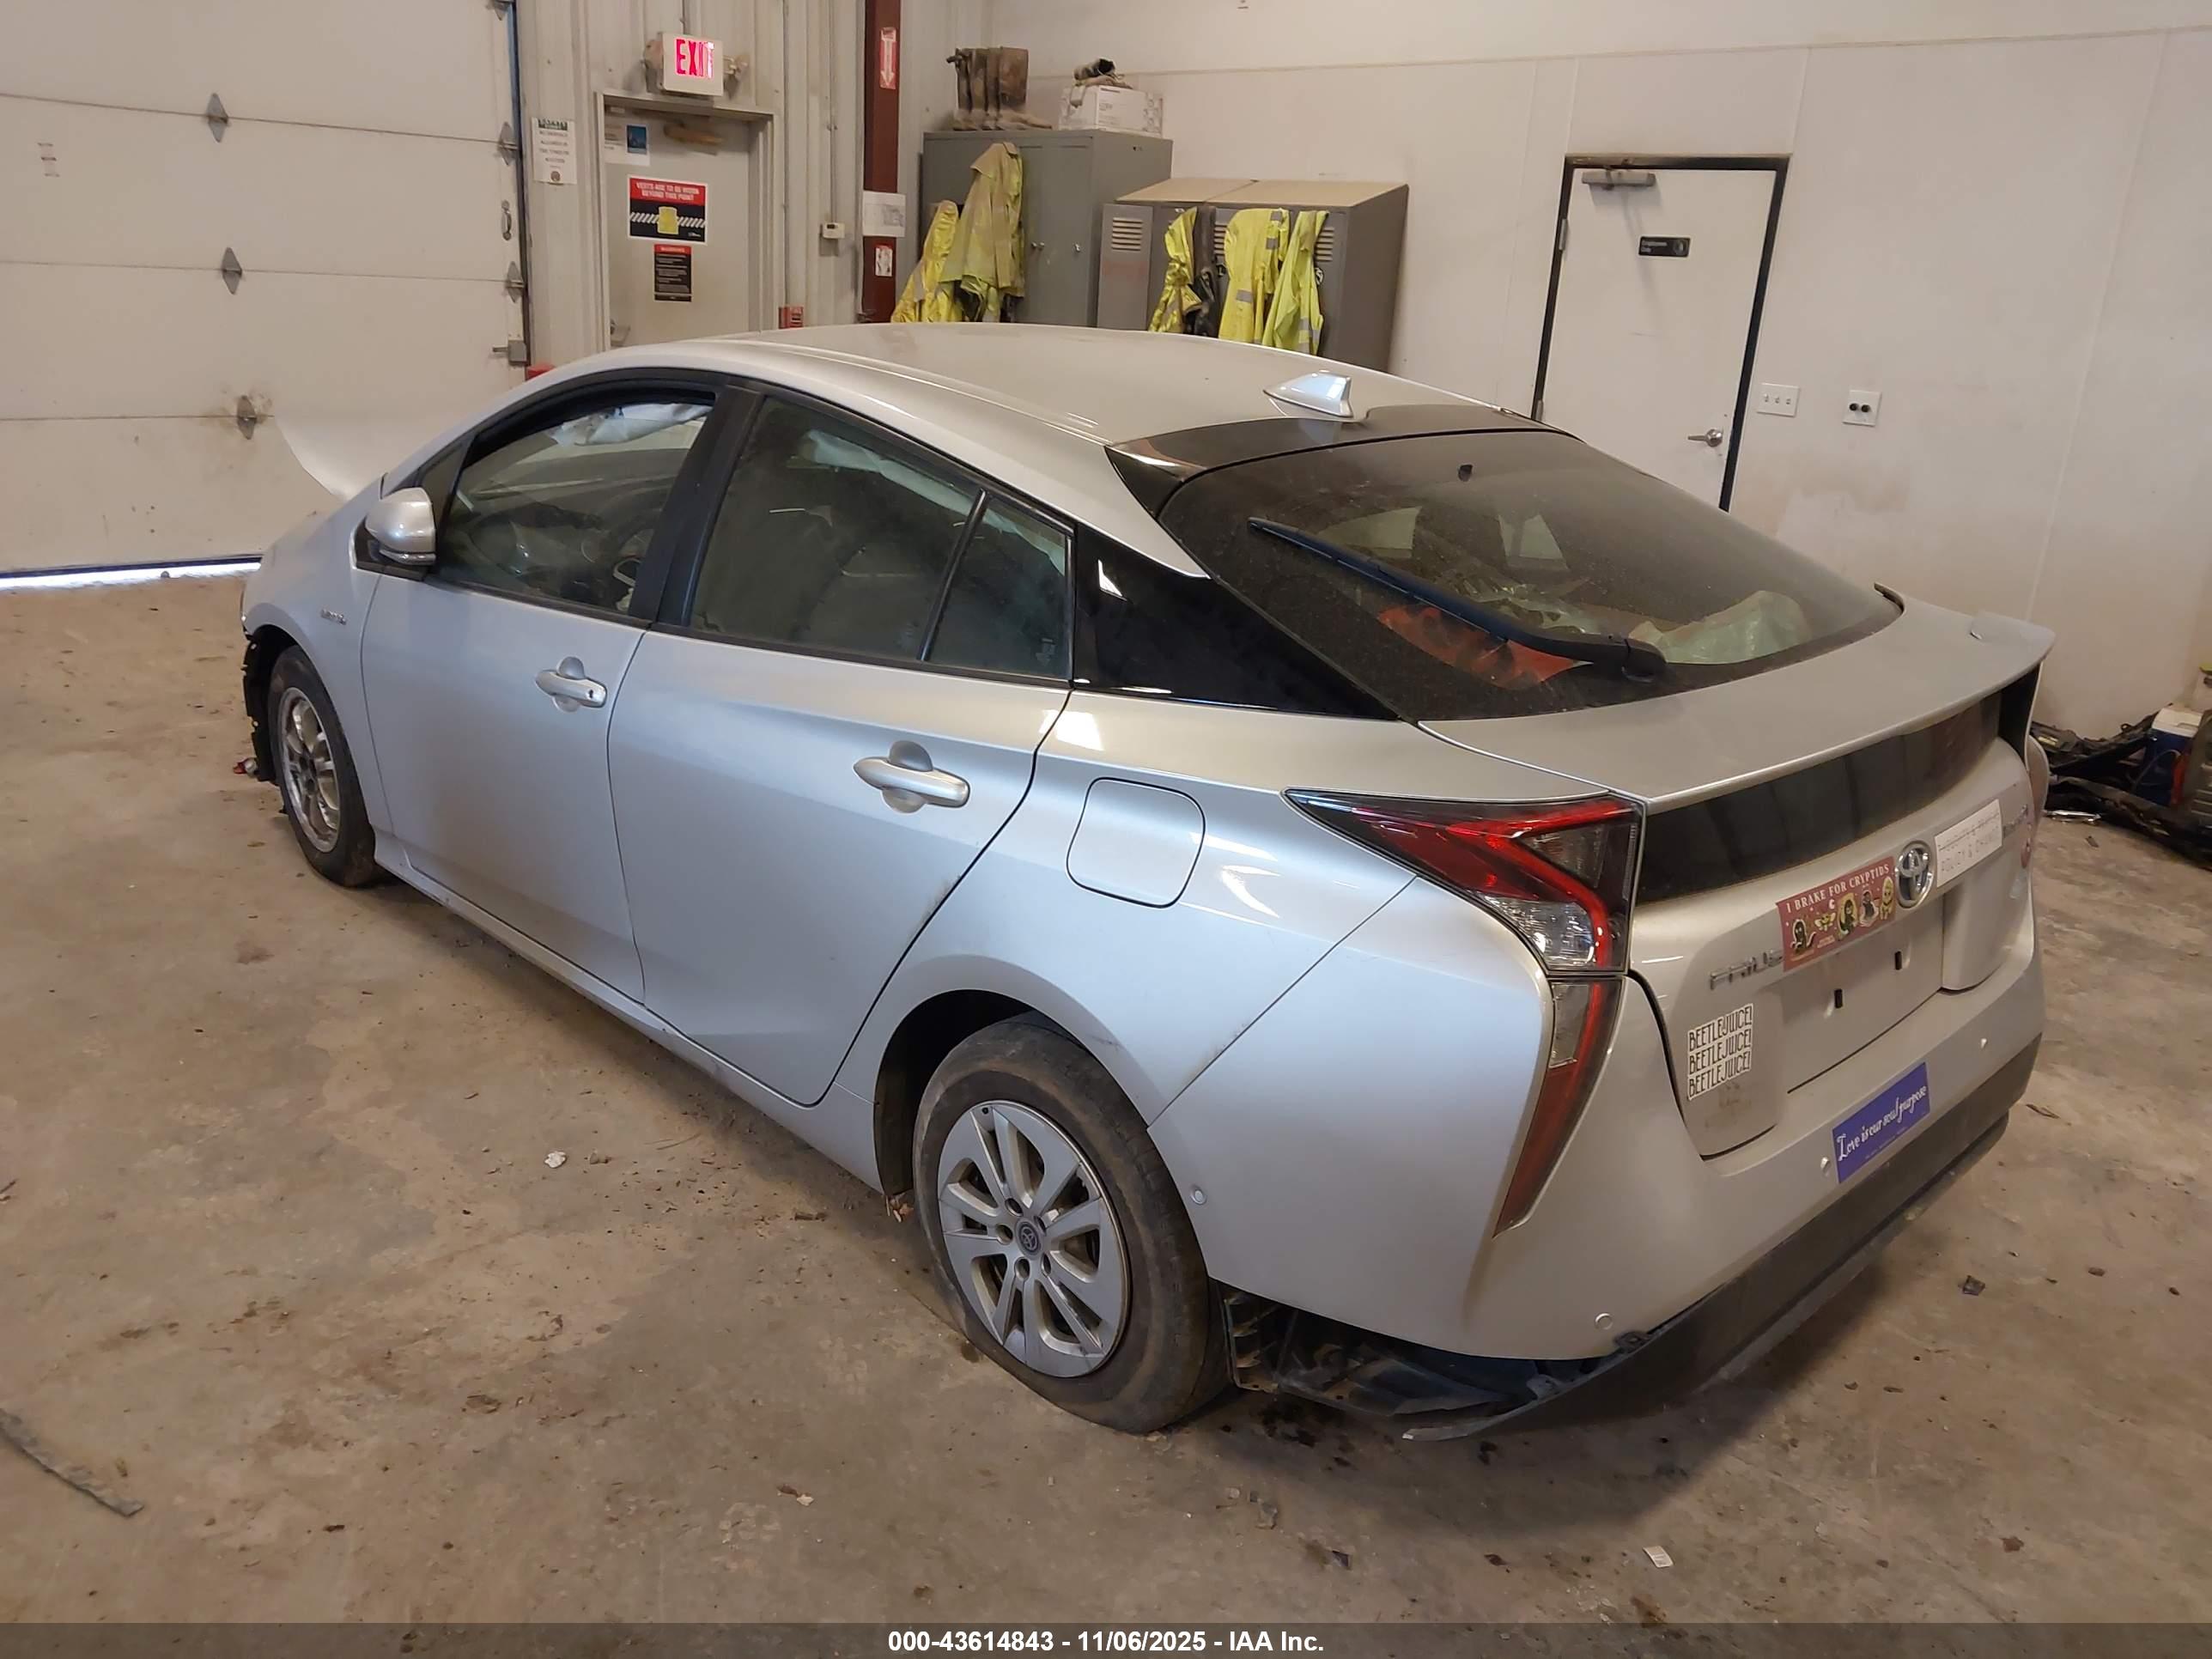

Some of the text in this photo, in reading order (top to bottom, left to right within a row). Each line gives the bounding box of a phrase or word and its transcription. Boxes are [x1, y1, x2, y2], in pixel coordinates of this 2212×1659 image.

[675, 38, 714, 78] EXIT
[1786, 864, 1889, 914] I BRAKE FOR CRYPTIDS
[1688, 1006, 1752, 1052] BEETLEJUICE!
[1688, 1028, 1751, 1074] BEETLEJUICE!
[1688, 1050, 1750, 1097] BEETLEJUICE!
[1836, 1133, 1860, 1161] Love
[1861, 1125, 1869, 1143] is
[1869, 1120, 1883, 1137] our
[1882, 1097, 1899, 1127] soul
[1897, 1085, 1927, 1123] purpose
